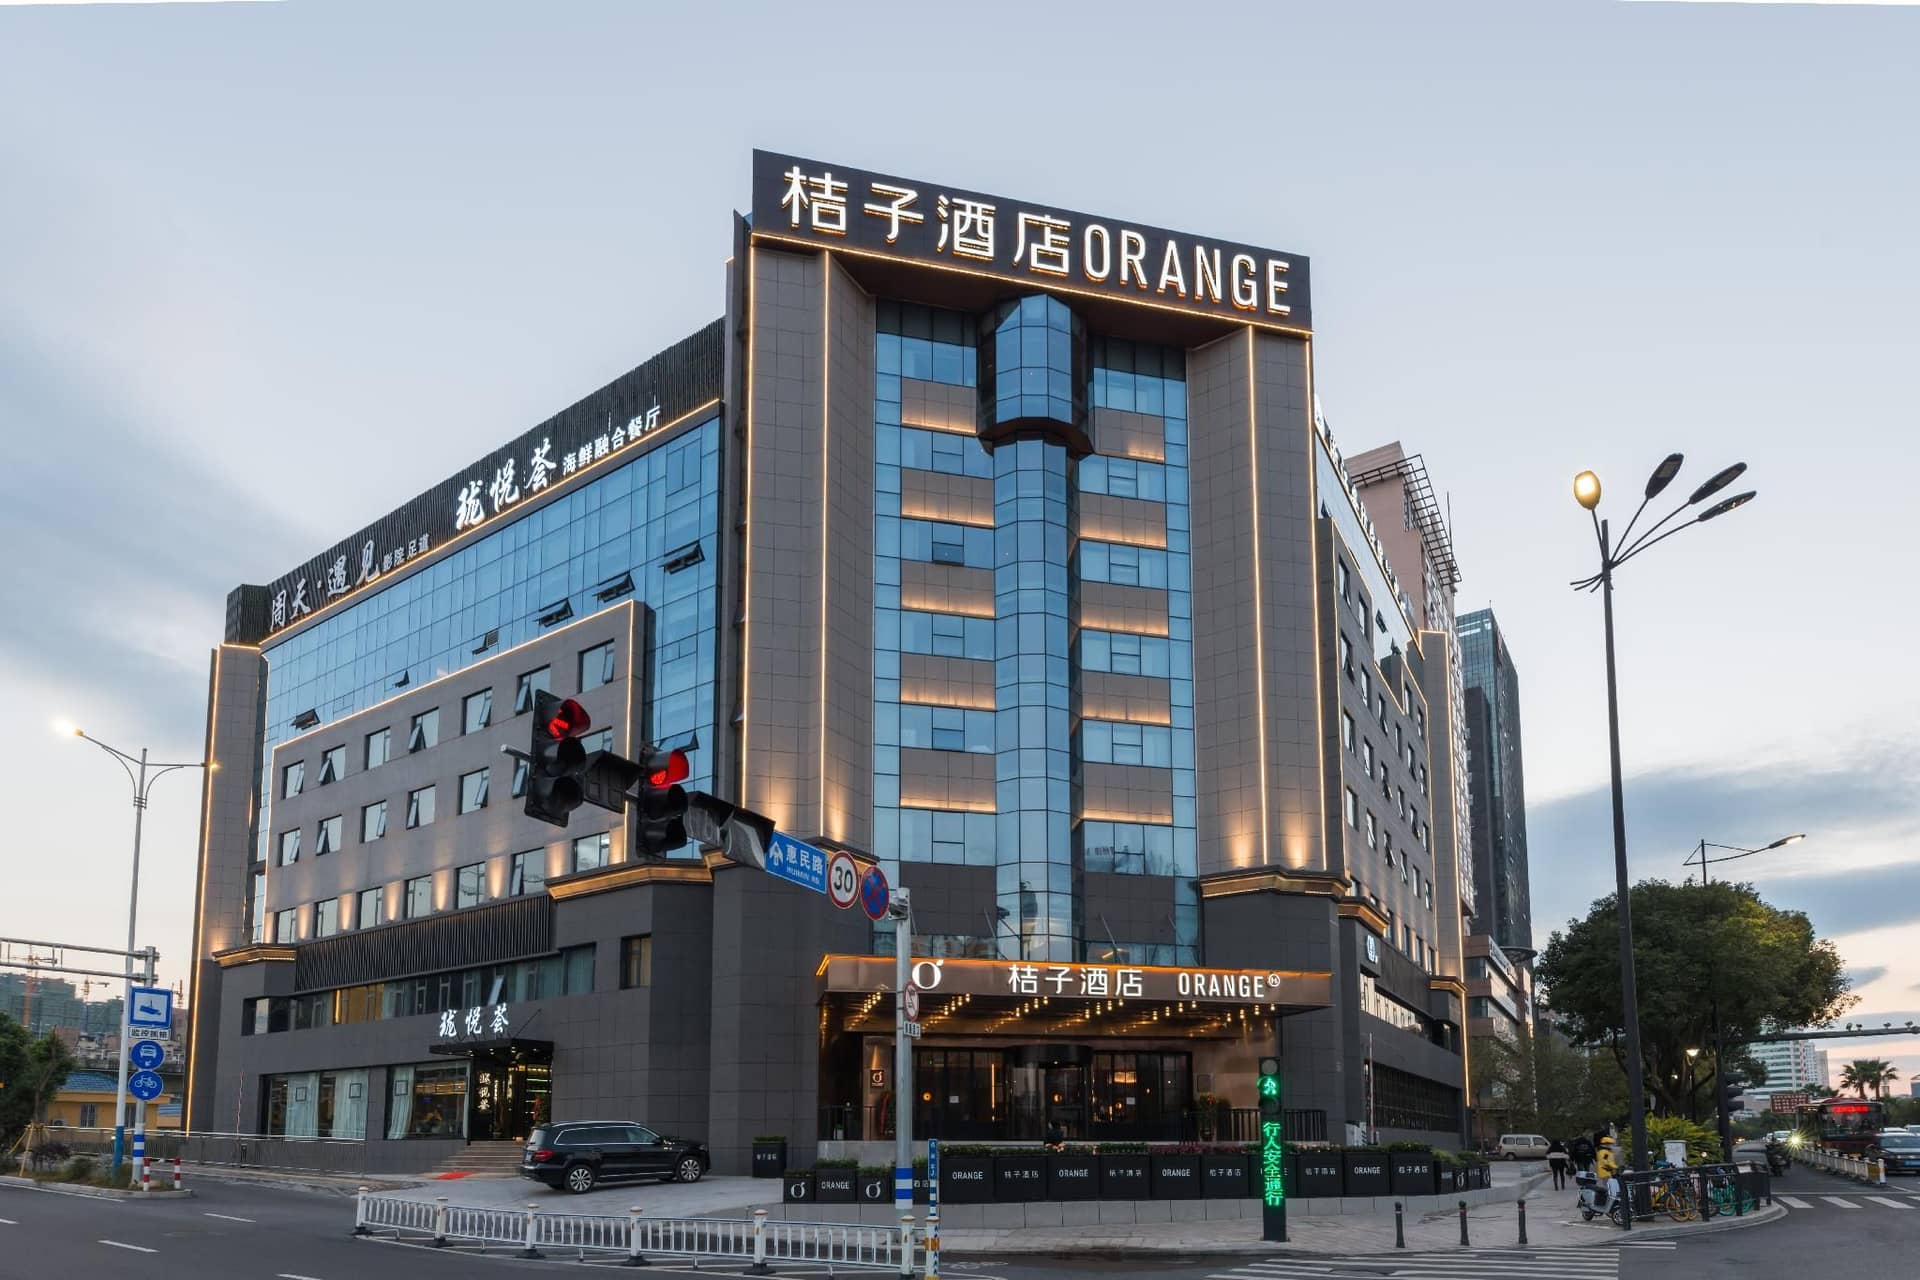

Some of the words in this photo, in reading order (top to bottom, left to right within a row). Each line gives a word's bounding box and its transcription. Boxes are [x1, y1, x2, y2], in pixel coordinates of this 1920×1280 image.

[782, 166, 1071, 278] 桔子酒店
[1084, 223, 1292, 314] ORANGE
[562, 405, 661, 476] 海鲜融合餐厅
[786, 844, 823, 875] 惠民路
[833, 866, 853, 893] 30
[1008, 964, 1143, 998] 桔子酒店
[1178, 972, 1264, 998] ORANGE
[952, 1171, 984, 1180] ORANGE
[1058, 1169, 1089, 1178] ORANGE
[1162, 1168, 1191, 1177] ORANGE
[1263, 1122, 1284, 1206] 行人安全通行
[1354, 1166, 1381, 1175] ORANGE
[821, 1181, 850, 1190] ORANGE
